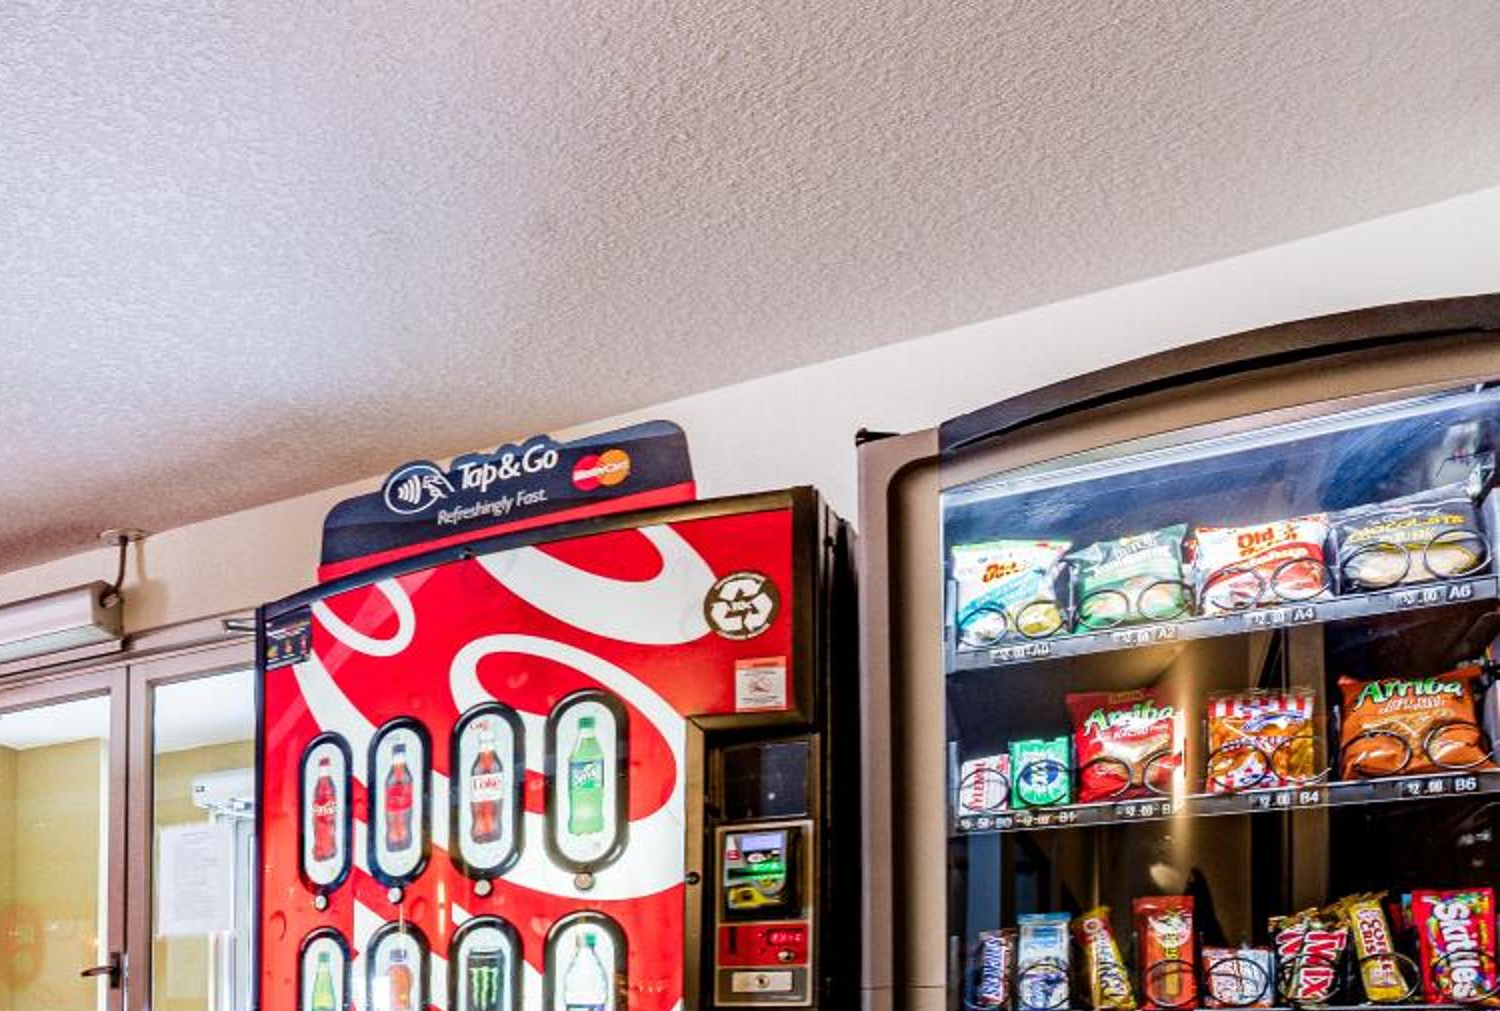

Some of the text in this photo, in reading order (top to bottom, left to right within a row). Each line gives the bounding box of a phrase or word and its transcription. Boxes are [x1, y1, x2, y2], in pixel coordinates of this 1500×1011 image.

[437, 496, 514, 526] Refreshingly
[1293, 608, 1314, 621] A4
[1353, 679, 1464, 712] Arriba
[1301, 931, 1348, 1001] TWIX
[1433, 903, 1480, 999] Skittles
